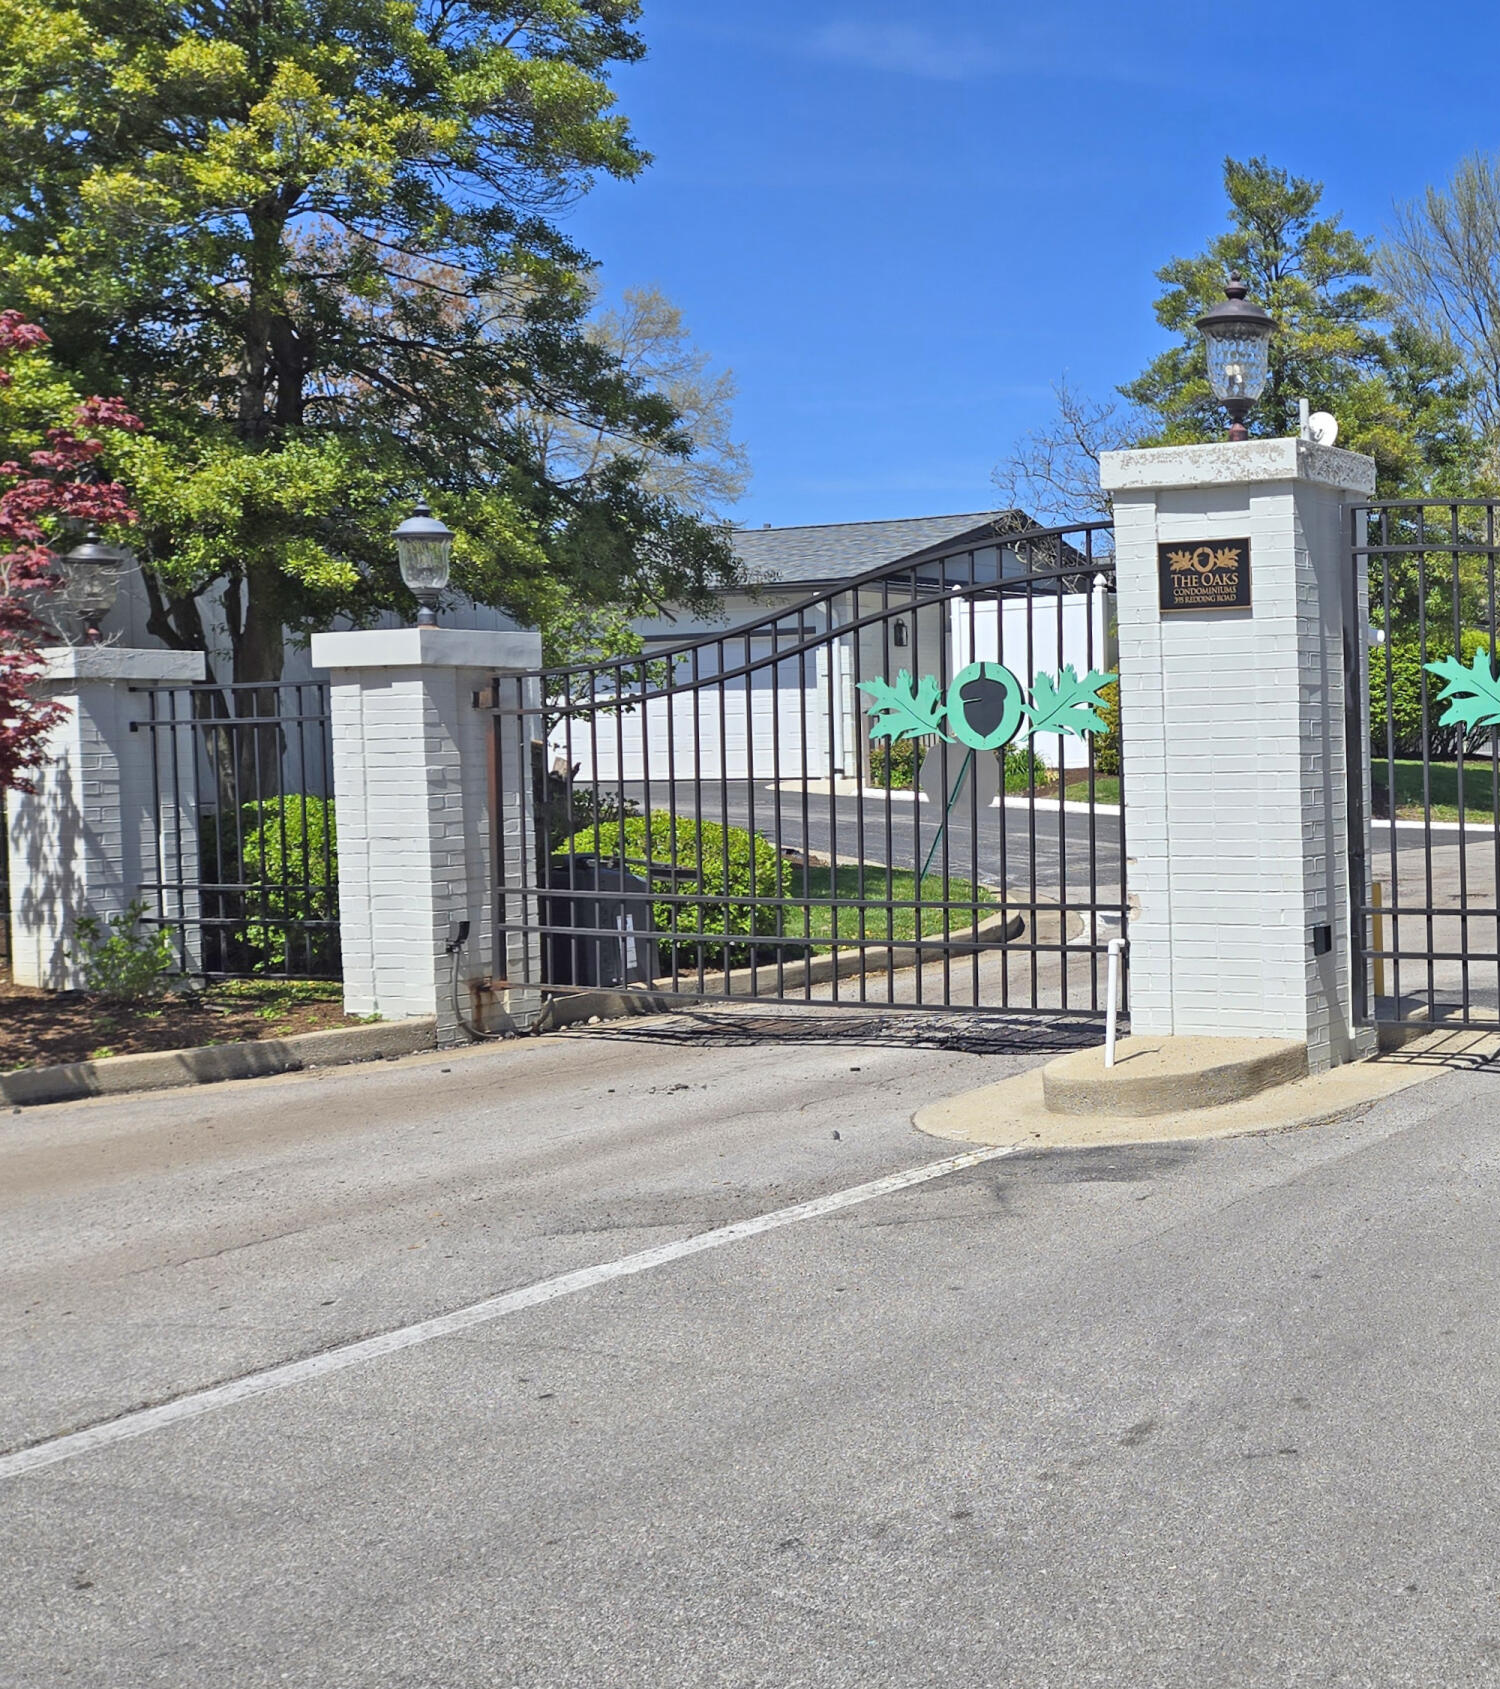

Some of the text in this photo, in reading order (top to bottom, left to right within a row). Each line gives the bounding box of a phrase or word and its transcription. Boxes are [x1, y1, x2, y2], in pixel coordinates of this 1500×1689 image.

[1171, 572, 1239, 587] THE OAKS
[1173, 586, 1237, 596] CONDOMINIUMS
[1217, 594, 1237, 602] ROAD
